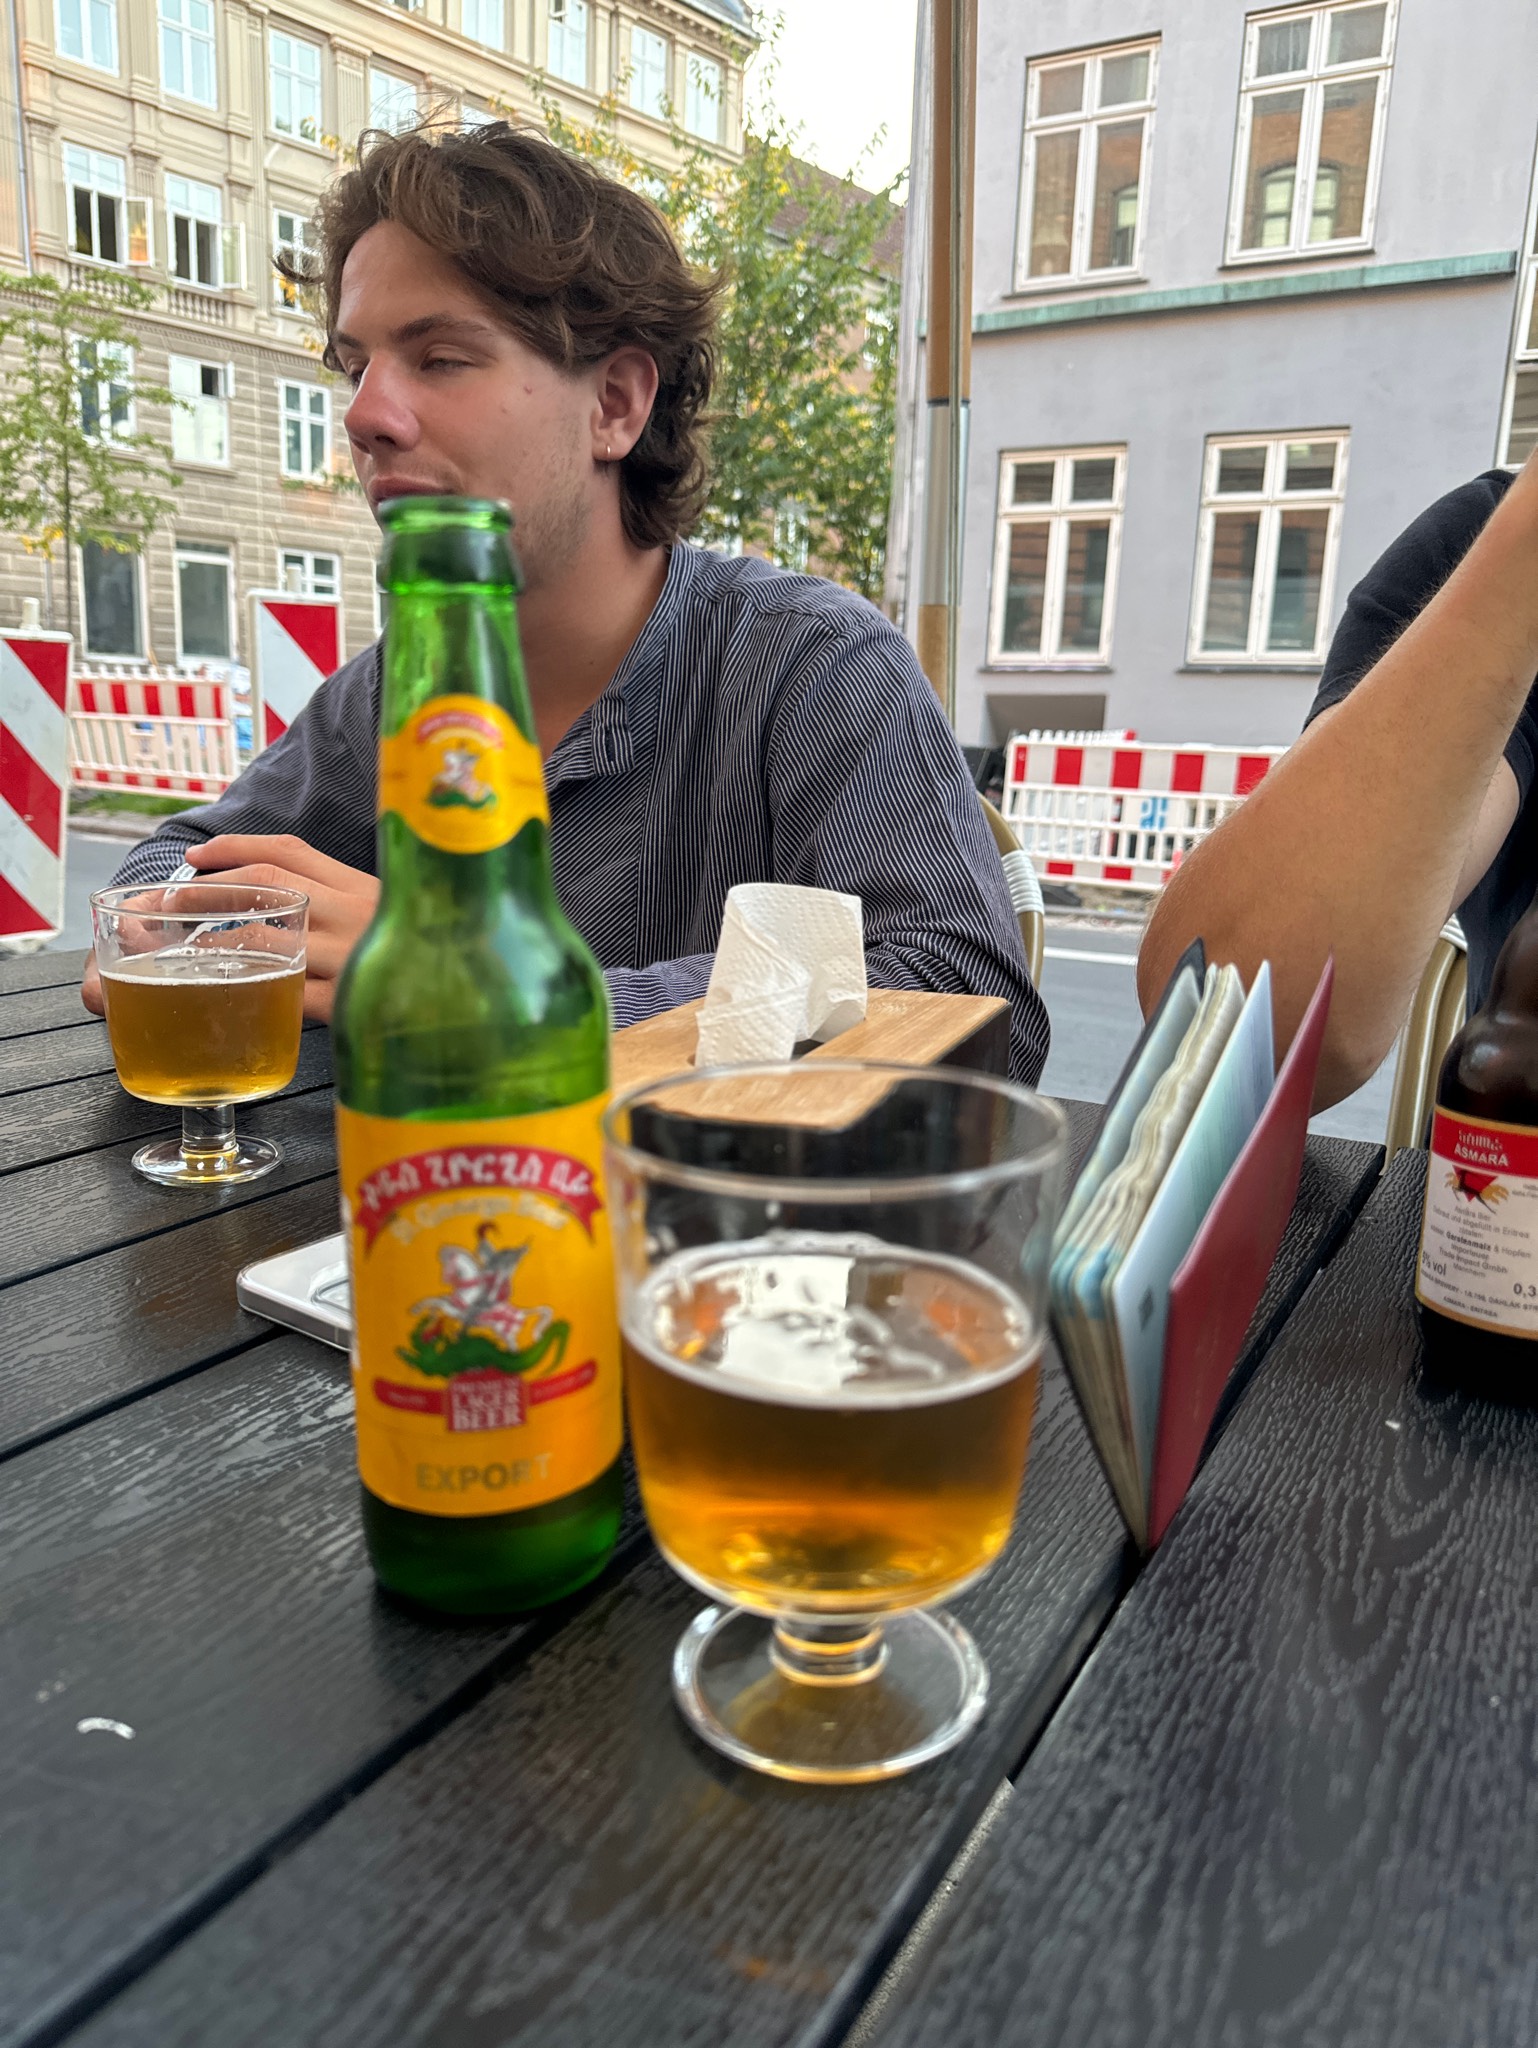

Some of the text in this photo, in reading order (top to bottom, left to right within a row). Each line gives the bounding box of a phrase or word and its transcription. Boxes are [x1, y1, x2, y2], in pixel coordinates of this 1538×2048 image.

[1454, 1143, 1508, 1167] ASMARA
[1502, 1226, 1530, 1239] Eritrea
[1446, 1231, 1492, 1252] Gerstenmalz
[1501, 1246, 1532, 1259] Hopfen
[1432, 1261, 1447, 1277] vol
[1439, 1247, 1455, 1259] Trade
[1456, 1255, 1480, 1268] Impact
[1435, 1278, 1460, 1293] BREWERY
[1488, 1297, 1521, 1310] DAHLAK
[1443, 1296, 1466, 1310] ASMARA
[1470, 1305, 1498, 1318] ERITREA
[454, 1405, 522, 1430] BEER
[416, 1452, 553, 1491] EXPORT
